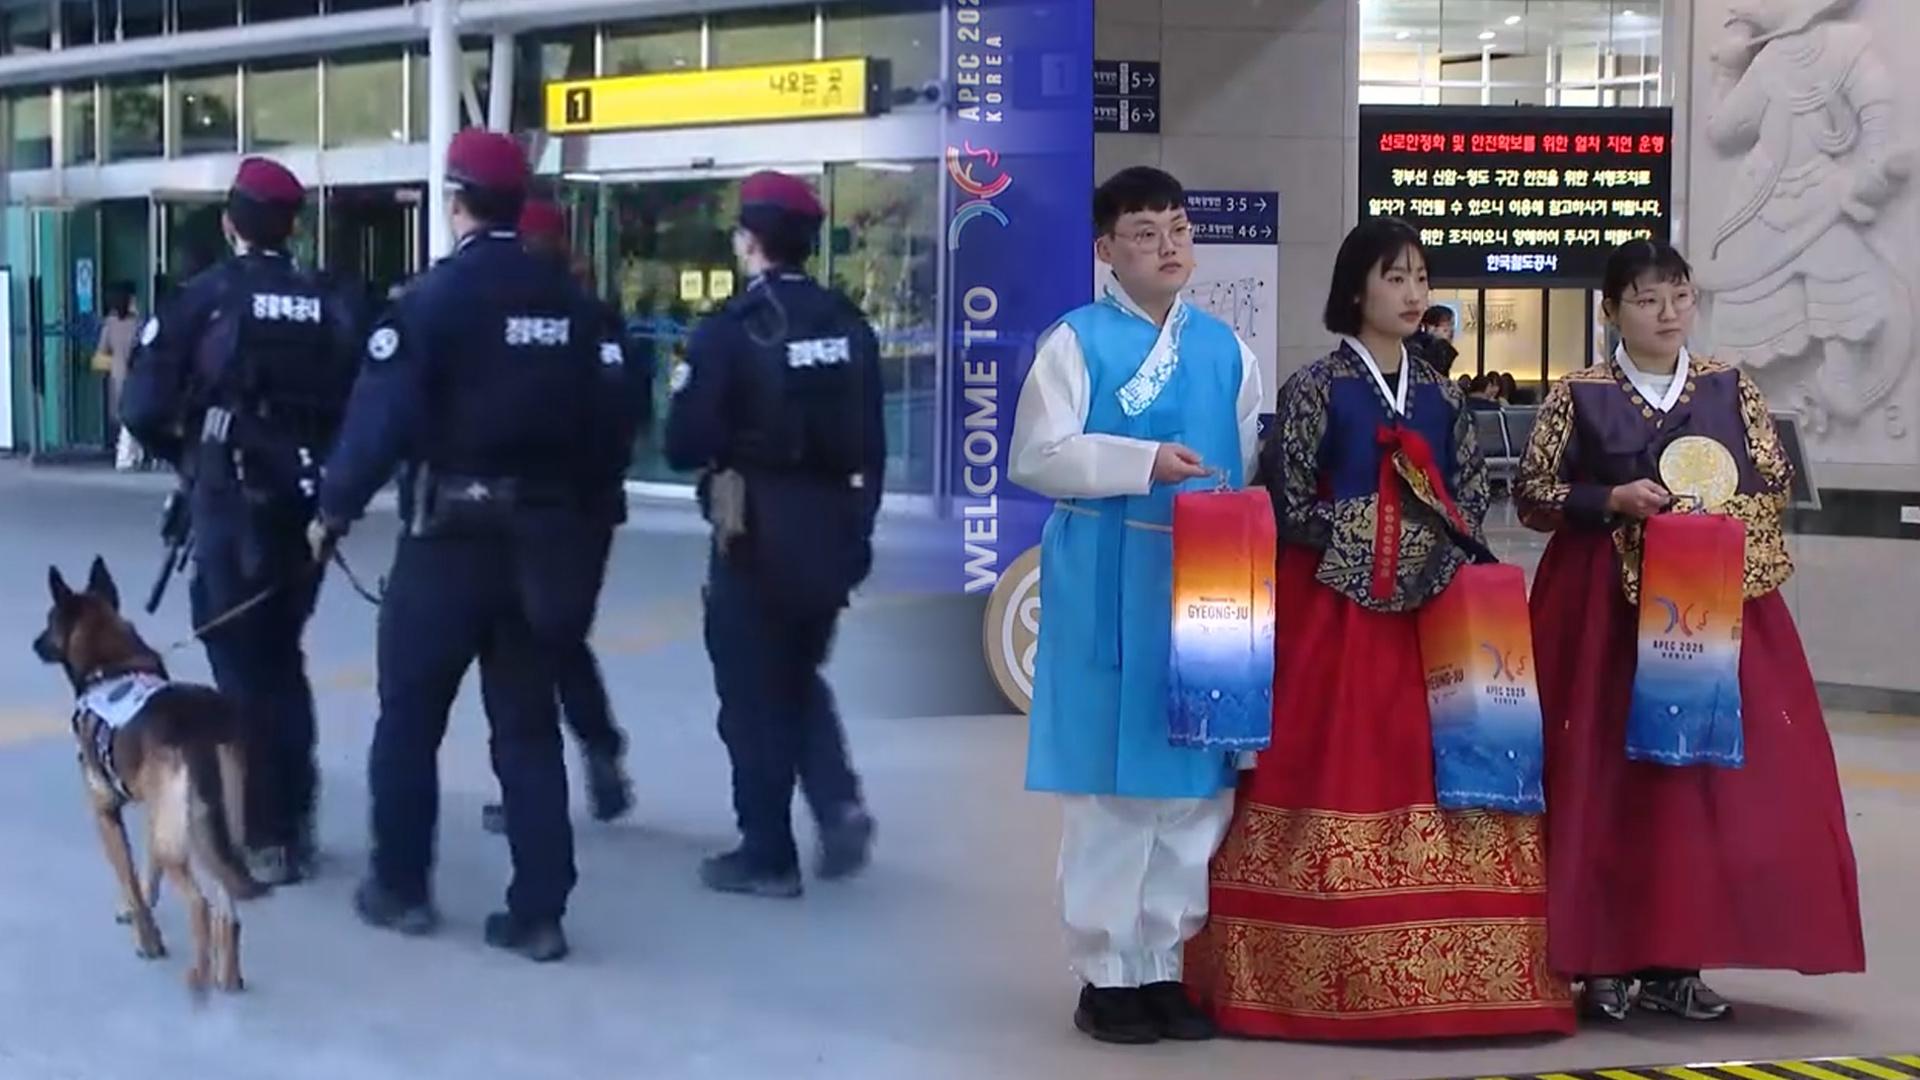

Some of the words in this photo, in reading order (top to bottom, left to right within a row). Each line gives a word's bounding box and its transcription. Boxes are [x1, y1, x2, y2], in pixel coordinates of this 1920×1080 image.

[957, 54, 981, 122] APEC
[986, 36, 1003, 122] KOREA
[1131, 72, 1141, 88] 5
[573, 90, 586, 119] 1
[1131, 107, 1141, 122] 6
[1379, 133, 1446, 152] 선로안정화
[1452, 134, 1465, 152] 및
[1471, 134, 1536, 152] 안전확보를
[1543, 134, 1568, 152] 위한
[1575, 134, 1600, 152] 열차
[1607, 134, 1632, 152] 지연
[1638, 134, 1664, 153] 운행
[1391, 168, 1428, 187] 경부선
[1494, 168, 1520, 187] 구간
[1523, 169, 1559, 187] 안전을
[1564, 169, 1588, 187] 위한
[1592, 169, 1651, 187] 서행조치로
[1368, 198, 1406, 216] 열차가
[1409, 198, 1446, 216] 지연될
[1450, 199, 1463, 216] 수
[1467, 198, 1504, 217] 있으니
[1508, 199, 1544, 217] 이용에
[1548, 199, 1607, 217] 참고하시기
[1420, 228, 1444, 246] 위한
[1448, 228, 1508, 246] 조치이오니
[1512, 228, 1560, 247] 양해하여
[1564, 228, 1600, 246] 주시기
[1486, 254, 1558, 272] 한국철도공사
[962, 285, 999, 349] TO
[963, 360, 999, 593] WELCOME
[1187, 604, 1249, 621] GYEONG-JU
[1652, 640, 1676, 651] APEC
